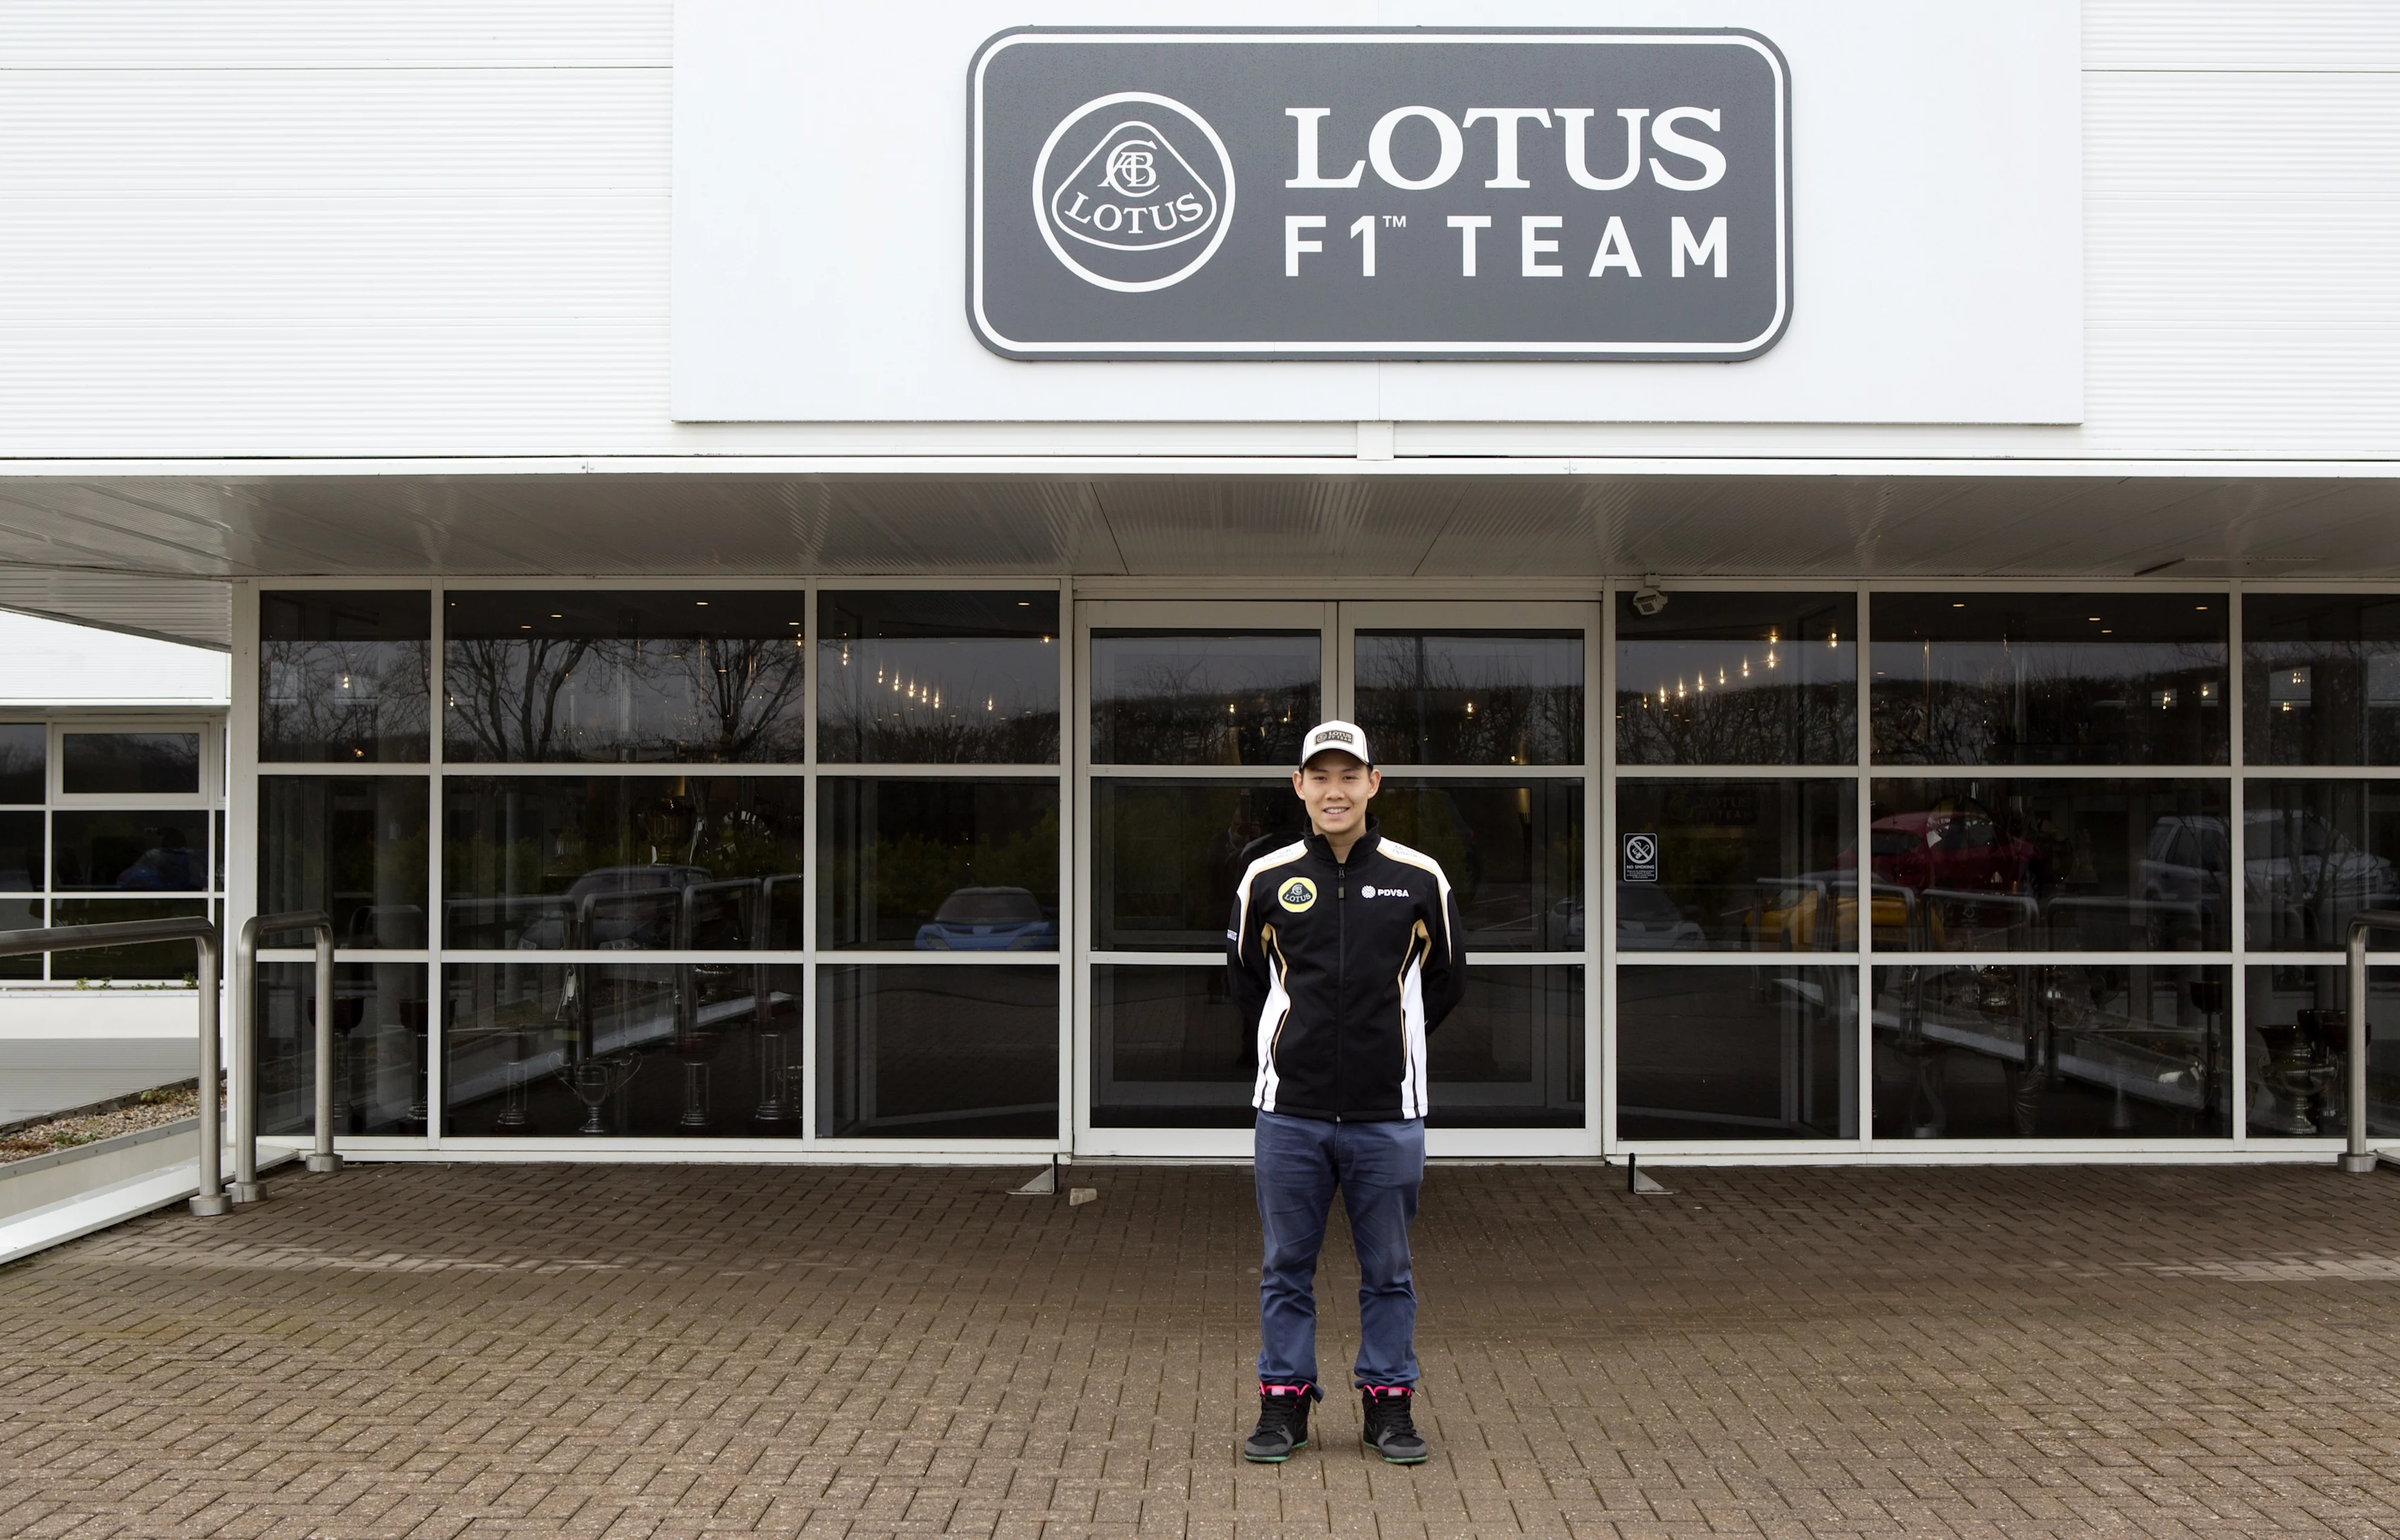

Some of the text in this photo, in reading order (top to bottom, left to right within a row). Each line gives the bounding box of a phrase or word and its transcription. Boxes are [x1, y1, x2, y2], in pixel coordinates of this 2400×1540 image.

[1286, 105, 1726, 191] LOTUS
[1064, 191, 1204, 234] LOTUS
[1447, 215, 1728, 278] TEAM
[1329, 731, 1352, 739] LOTUS
[1284, 893, 1311, 903] LOTUS
[1377, 888, 1409, 898] PDVSA
